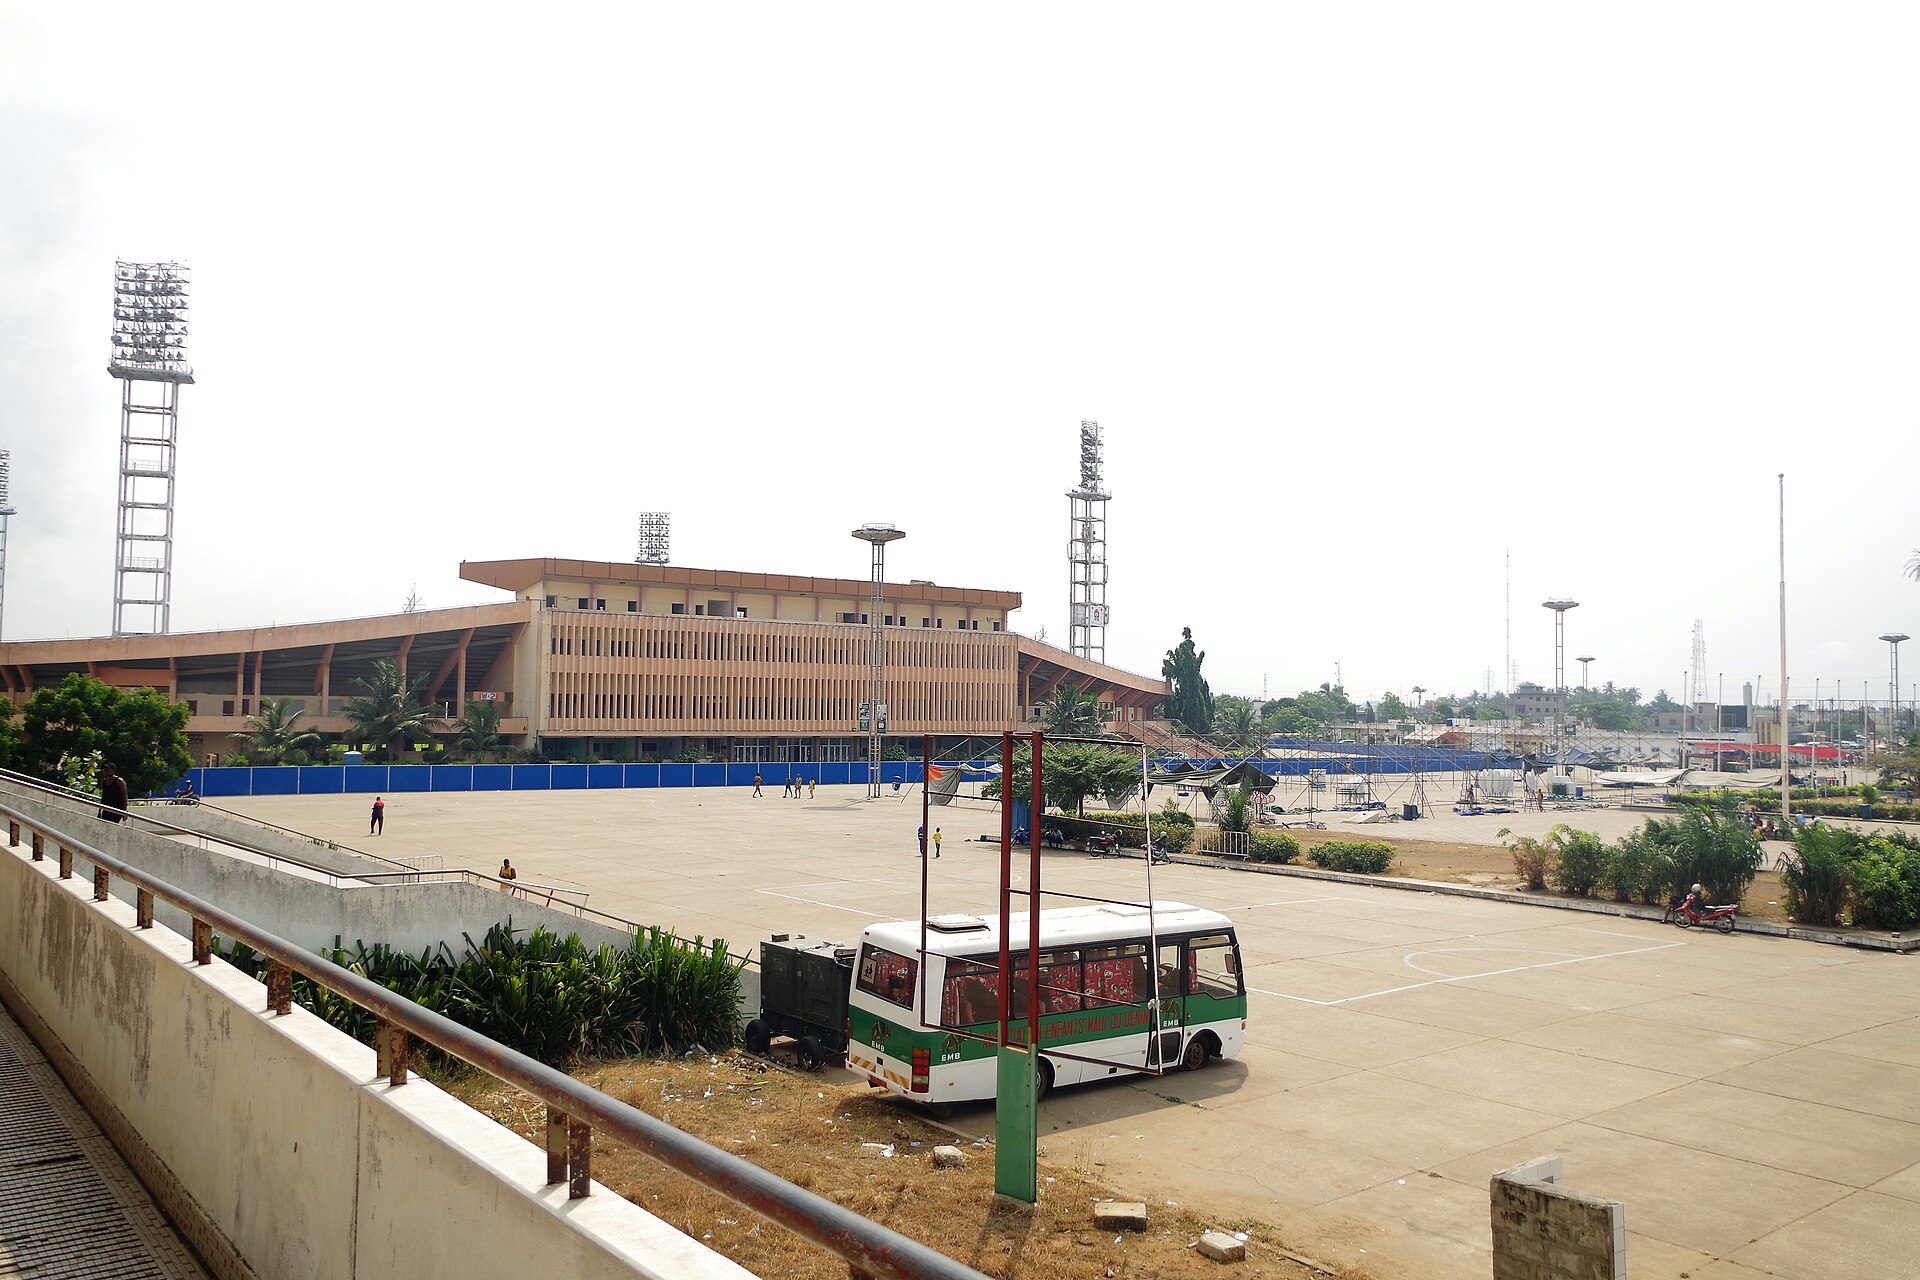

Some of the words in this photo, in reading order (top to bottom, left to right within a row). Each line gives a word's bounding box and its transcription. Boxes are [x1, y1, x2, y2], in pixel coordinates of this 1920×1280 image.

[1045, 1018, 1085, 1040] ENFANTS
[1111, 1012, 1122, 1030] DU
[1163, 1019, 1179, 1027] EMB
[871, 1040, 885, 1052] EMB
[941, 1052, 961, 1062] EMB
